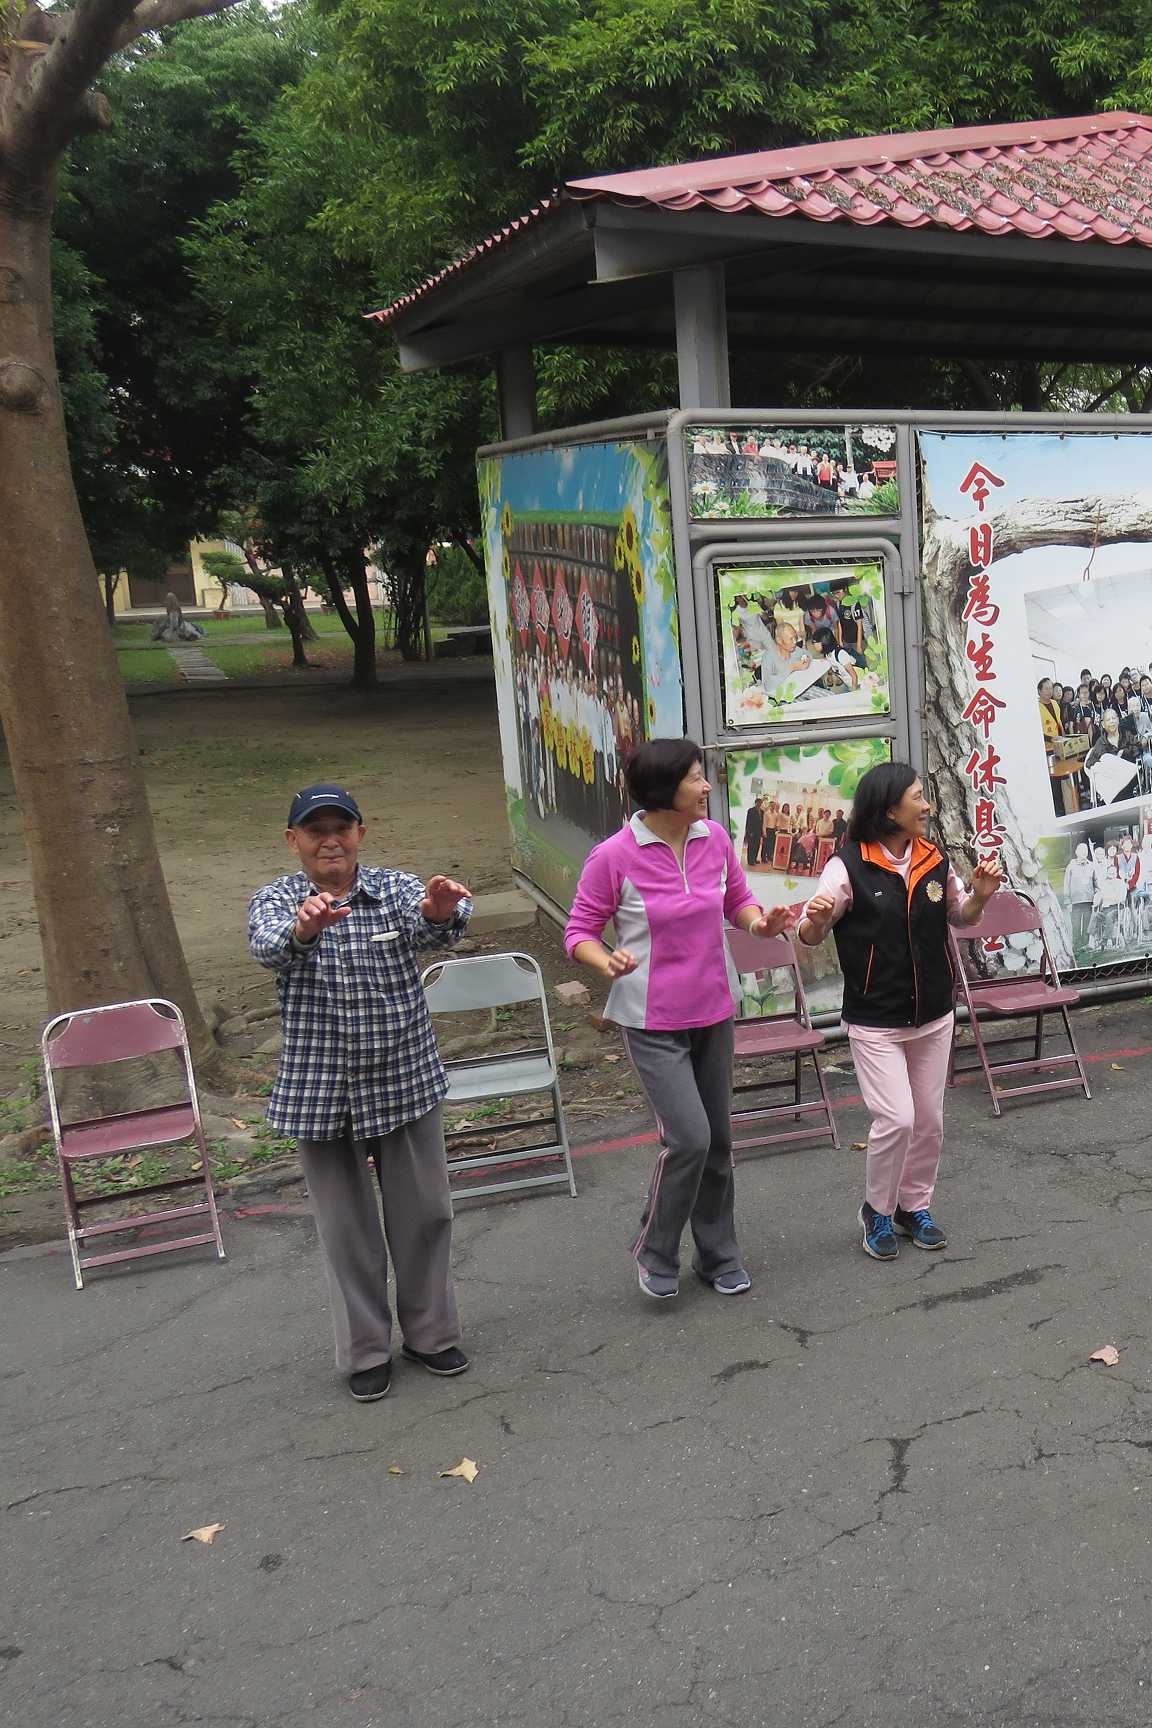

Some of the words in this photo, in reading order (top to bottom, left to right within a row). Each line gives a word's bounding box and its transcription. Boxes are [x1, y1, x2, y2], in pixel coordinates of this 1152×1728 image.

[960, 462, 1007, 952] 今日為生命休息
